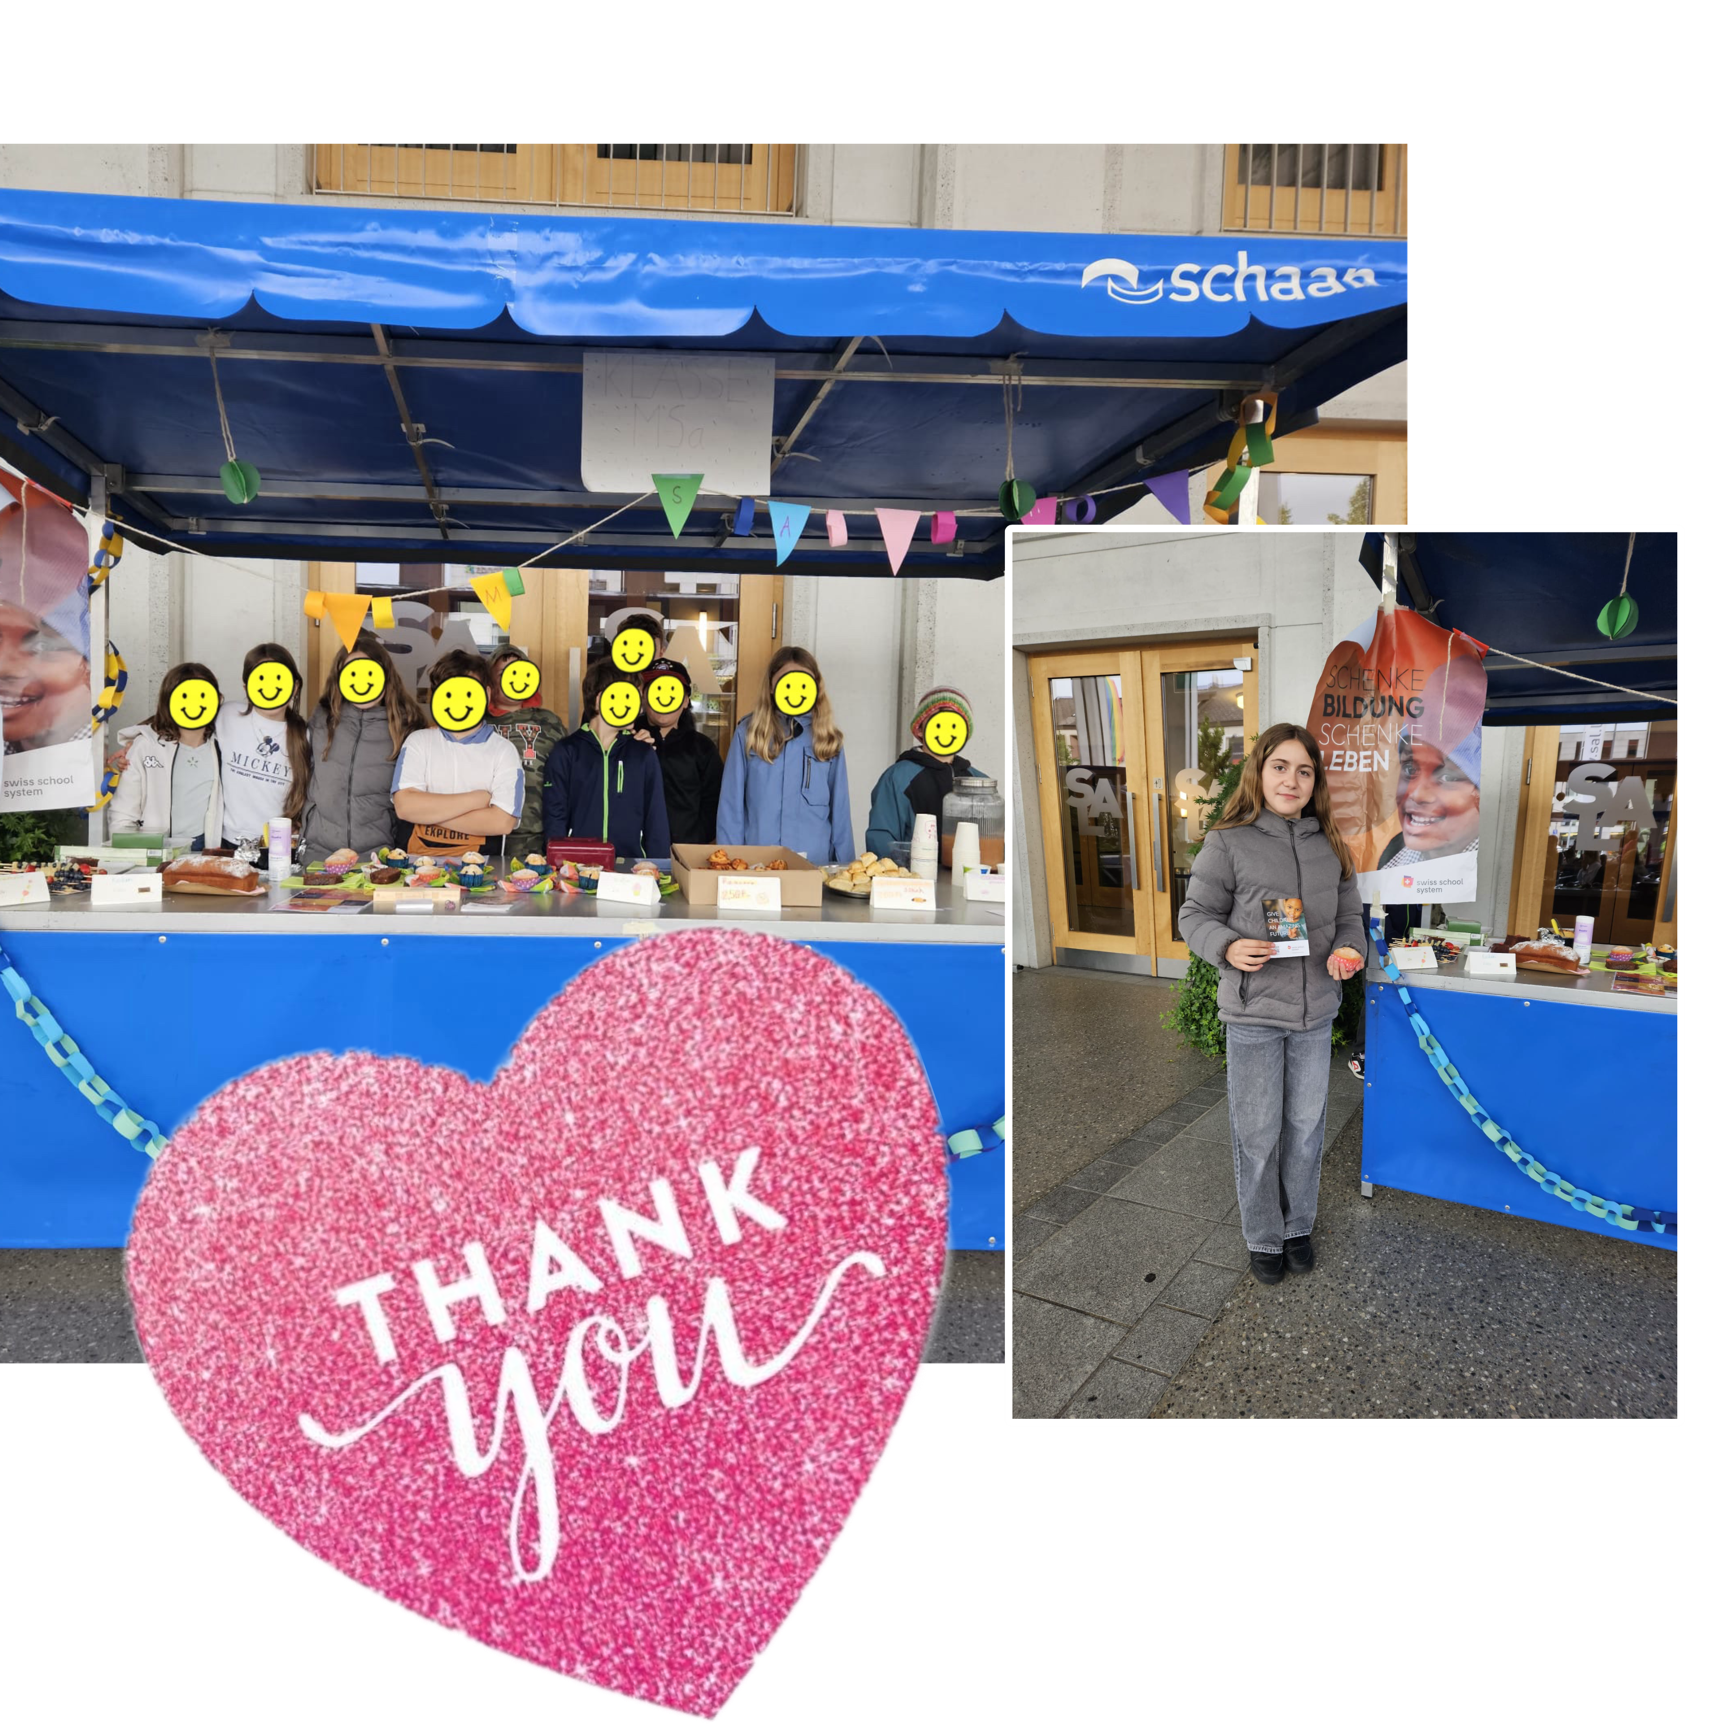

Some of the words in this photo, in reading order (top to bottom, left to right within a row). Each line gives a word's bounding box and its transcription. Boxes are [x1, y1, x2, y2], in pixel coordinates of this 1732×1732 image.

[1168, 250, 1381, 302] schaan
[604, 353, 749, 403] KLASSE
[485, 586, 503, 606] M
[672, 485, 683, 504] S
[779, 516, 791, 537] A
[1325, 664, 1425, 691] SCHENKE
[1322, 693, 1425, 719] BILDUNG
[1318, 722, 1424, 746] SCHENKE
[230, 751, 293, 777] MICKEY
[3, 777, 35, 788] swiss
[37, 774, 74, 786] school
[3, 788, 44, 799] system
[424, 824, 470, 840] EXPLORE
[1416, 878, 1438, 886] swiss
[1439, 877, 1464, 886] school
[1416, 886, 1443, 895] system
